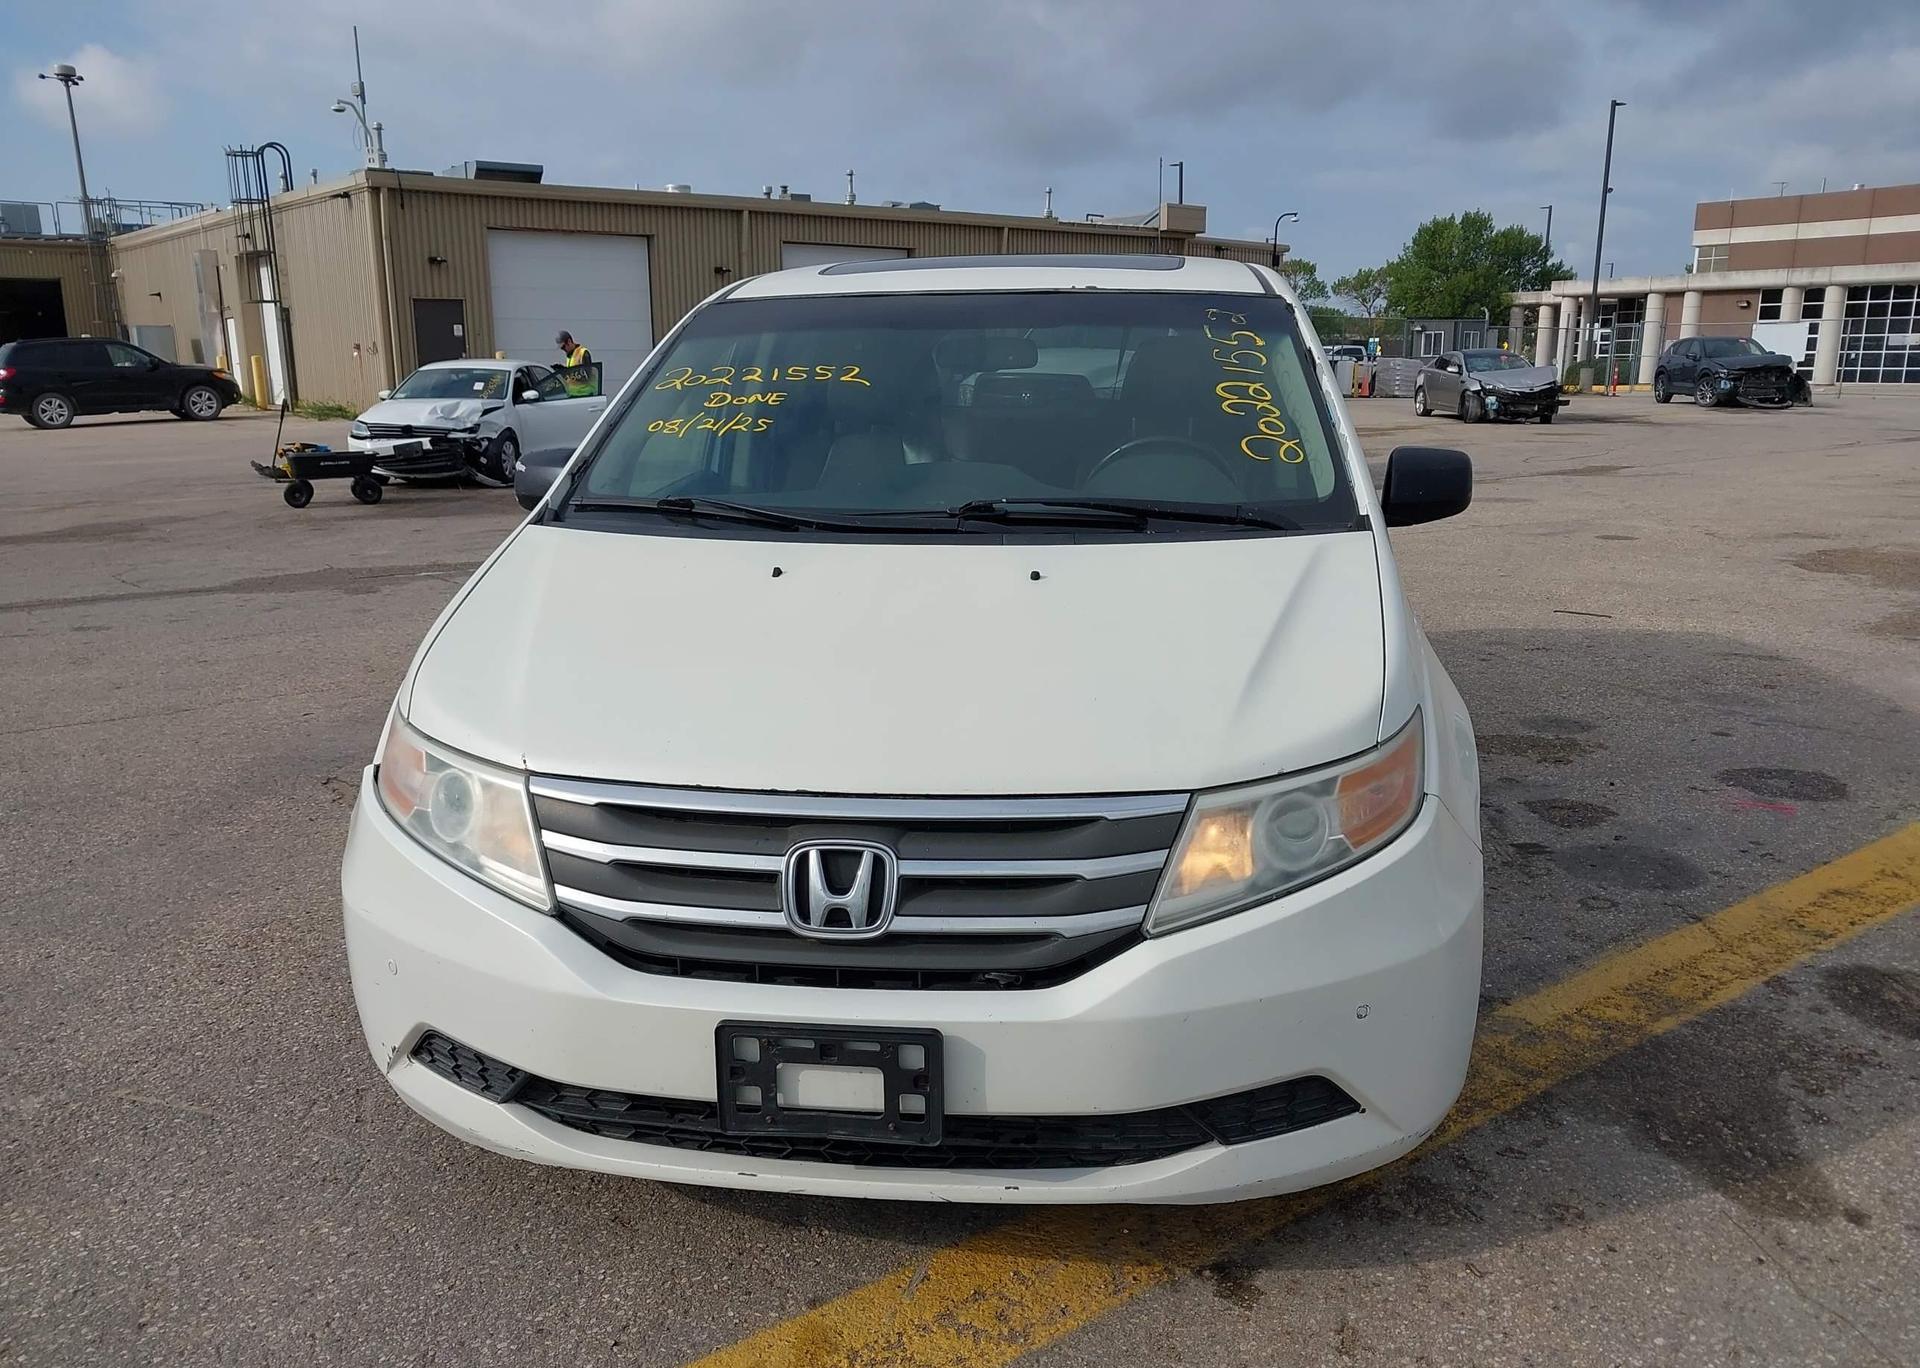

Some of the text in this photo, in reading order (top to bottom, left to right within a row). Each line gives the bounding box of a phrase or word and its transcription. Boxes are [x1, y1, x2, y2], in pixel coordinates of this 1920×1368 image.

[655, 365, 871, 391] 20221552
[1203, 307, 1304, 464] 20221552
[647, 412, 774, 438] 08/21/25
